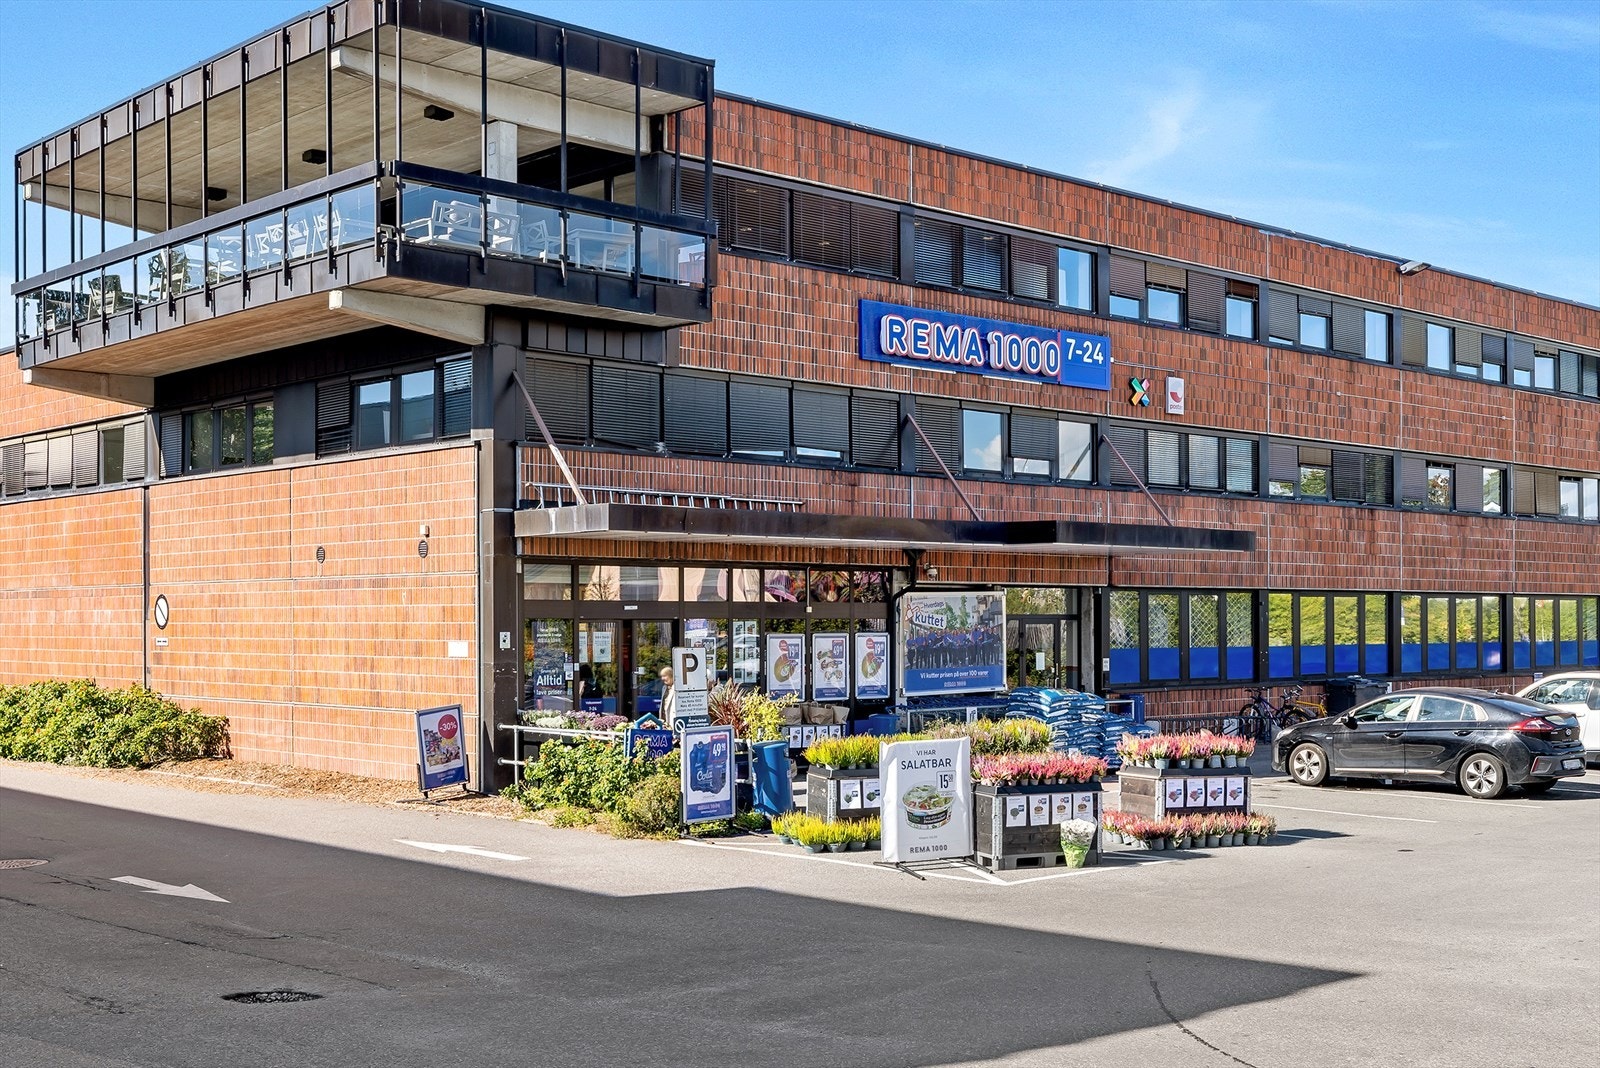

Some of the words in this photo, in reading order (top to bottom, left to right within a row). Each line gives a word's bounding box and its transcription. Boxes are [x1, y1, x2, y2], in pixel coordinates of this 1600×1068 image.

[881, 314, 983, 366] REMA
[988, 331, 1060, 376] 1000
[1065, 338, 1105, 365] 7-24
[681, 653, 699, 686] P
[940, 671, 953, 679] prisen
[536, 674, 563, 686] Alltid
[440, 722, 457, 731] -30%
[713, 743, 721, 756] 49
[901, 757, 952, 770] SALATBAR
[940, 774, 949, 789] 15
[931, 844, 947, 852] 1000
